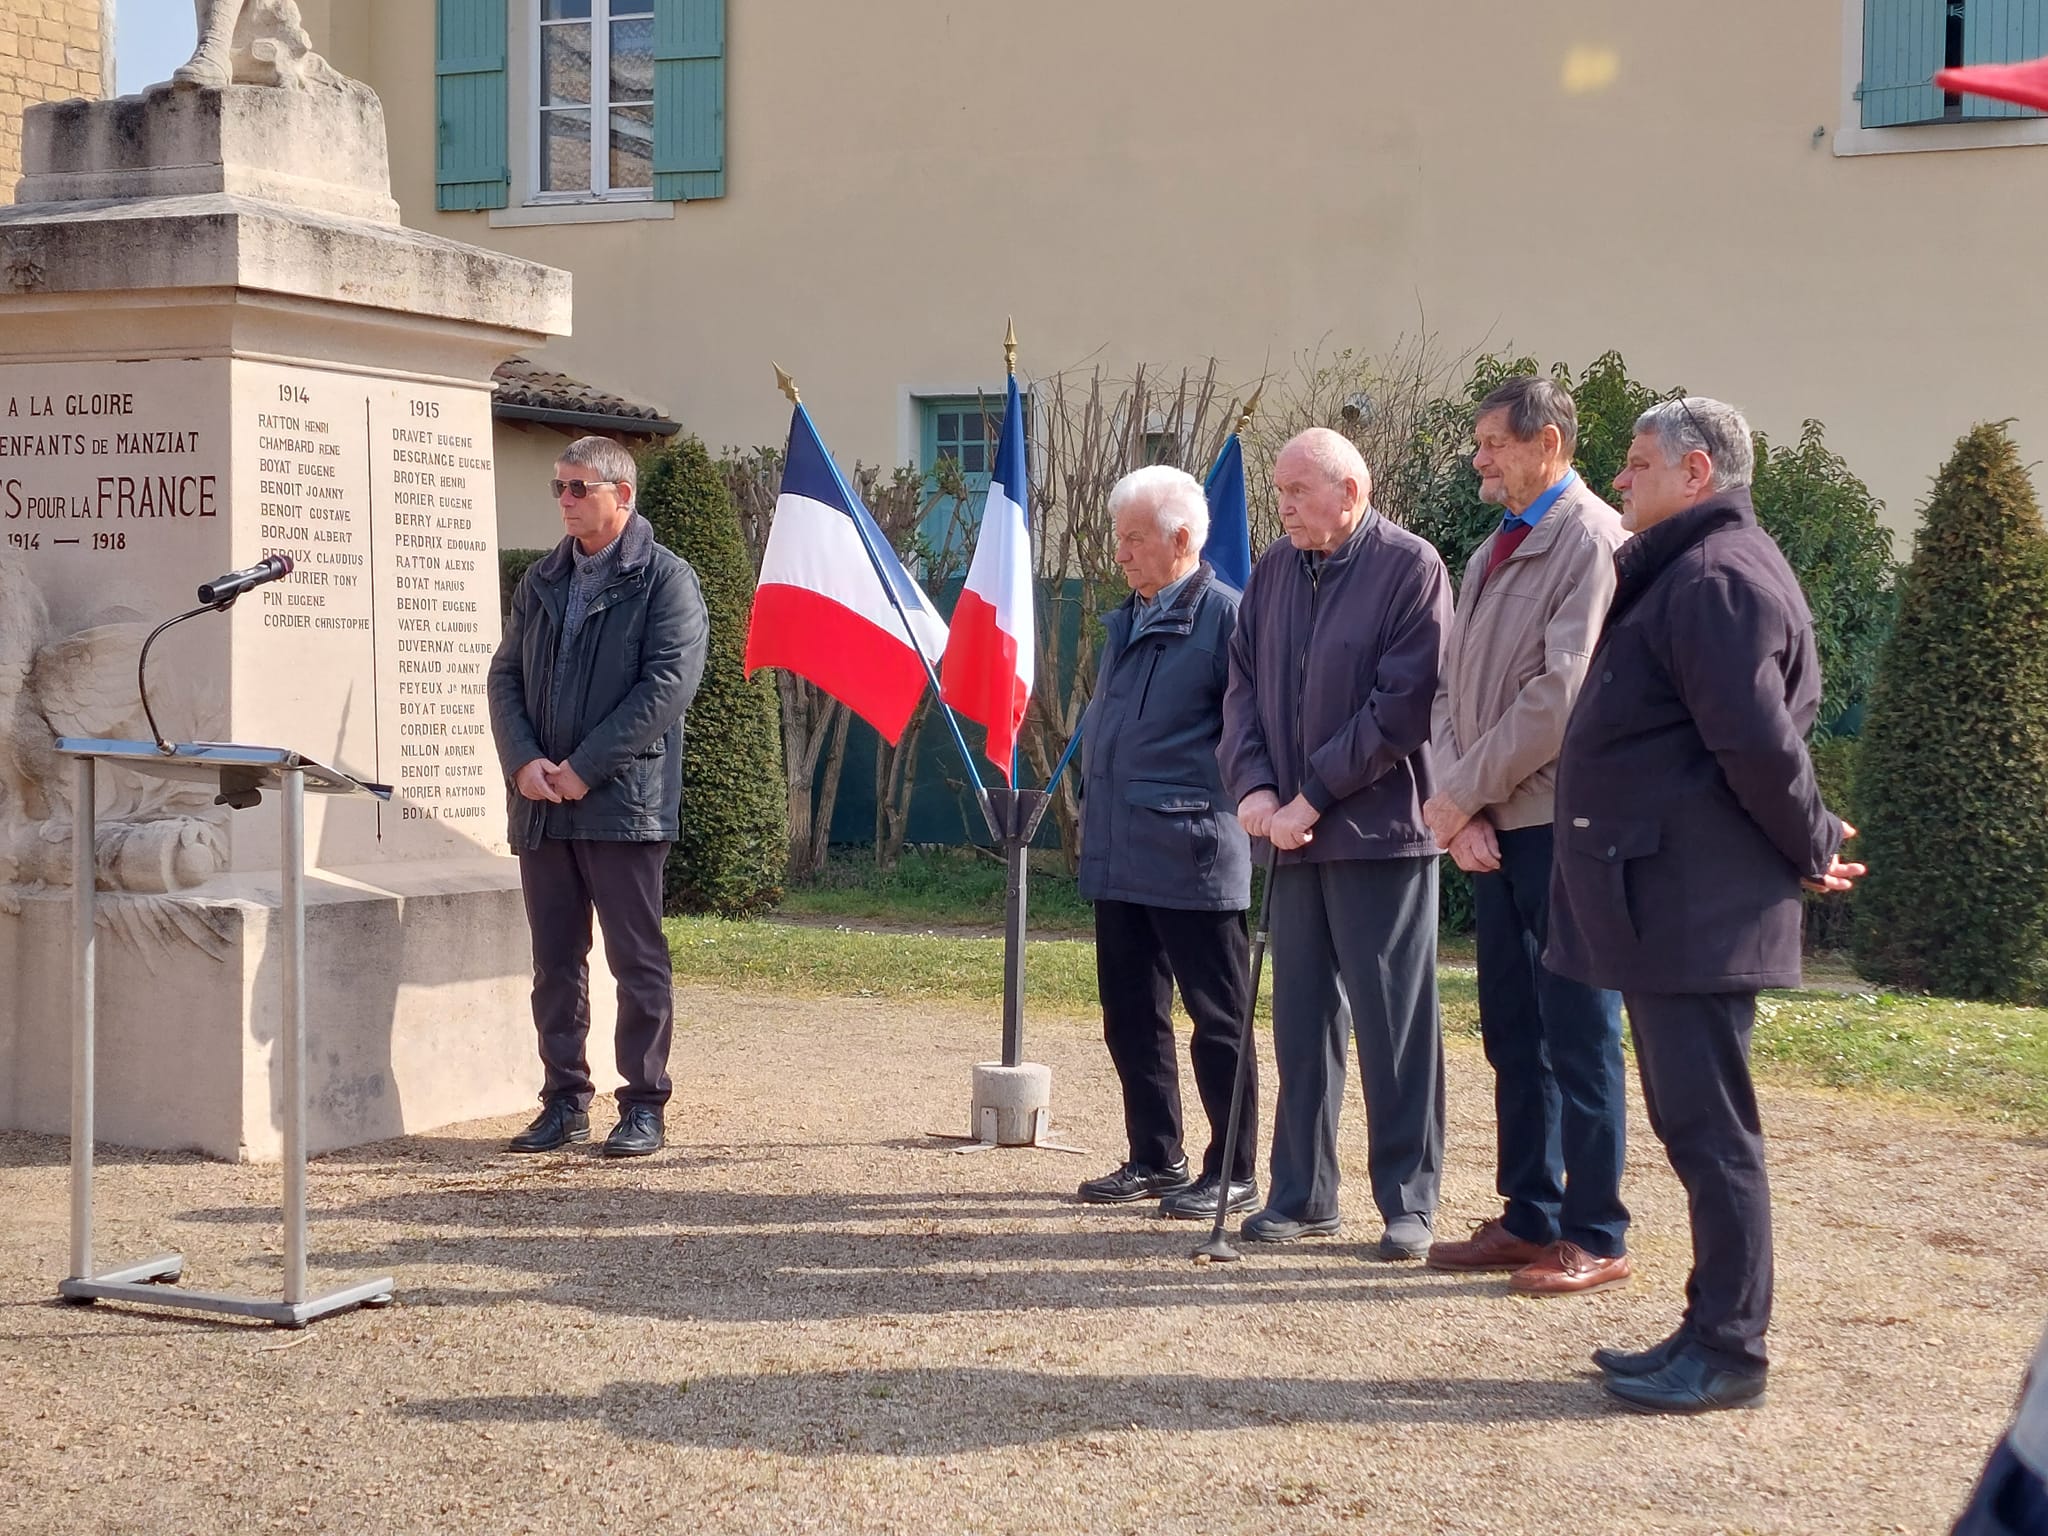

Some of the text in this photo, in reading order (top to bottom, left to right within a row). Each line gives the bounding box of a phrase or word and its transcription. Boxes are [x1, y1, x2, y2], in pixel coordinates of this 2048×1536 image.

[279, 384, 310, 404] 1914
[8, 394, 133, 417] A LA GLOIRE
[409, 400, 440, 419] 1915
[258, 414, 329, 434] RATTON HENRI
[0, 432, 199, 456] ENFANTS DE MANZIAT
[259, 436, 340, 455] CHAMBARD RENE
[437, 434, 472, 448] EUGENE
[260, 458, 335, 477] BOYAT EUGENE
[458, 457, 492, 471] EUGENE
[393, 470, 466, 489] BROYER HENRI
[27, 497, 66, 519] POUR
[71, 497, 91, 518] LA
[96, 476, 217, 518] FRANCE
[260, 480, 344, 499] BENOIT JOANNY
[394, 491, 473, 510] MORIER EUGENE
[261, 502, 351, 521] BENOIT GUSTAVE
[395, 512, 472, 530] BERRY ALFRED
[8, 533, 40, 550] 1914
[92, 533, 126, 550] 1918
[261, 525, 352, 543] BORJON ALBERT
[395, 533, 486, 552] PERDRIX EDOUARD
[316, 552, 363, 566] CLAUDIUS
[396, 555, 475, 571] RATTON ALEXIS
[271, 571, 358, 587] TURIER TONY
[396, 576, 465, 591] BOYAT MARIUS
[263, 591, 326, 607] PIN EUGENE
[397, 597, 477, 612] BENOIT EUGENE
[264, 614, 370, 630] CORDIER CHRISTOPHE
[398, 618, 478, 633] VAYER CLAUDIUS
[398, 639, 492, 654] DUVERNAY CLAUDE
[399, 660, 480, 674] RENAUD JOANNY
[399, 682, 443, 694] FEYEUX
[461, 684, 486, 695] MARIE
[400, 703, 475, 715] BOYAT EUGENE
[400, 723, 484, 736] CORDIER CLAUDE
[401, 744, 475, 757] NILLON ADRIEN
[401, 765, 483, 778] BENOIT GUSTAVE
[402, 786, 486, 799] MORIER RAYMOND
[402, 806, 486, 820] BOYAT CLAUDIUS
